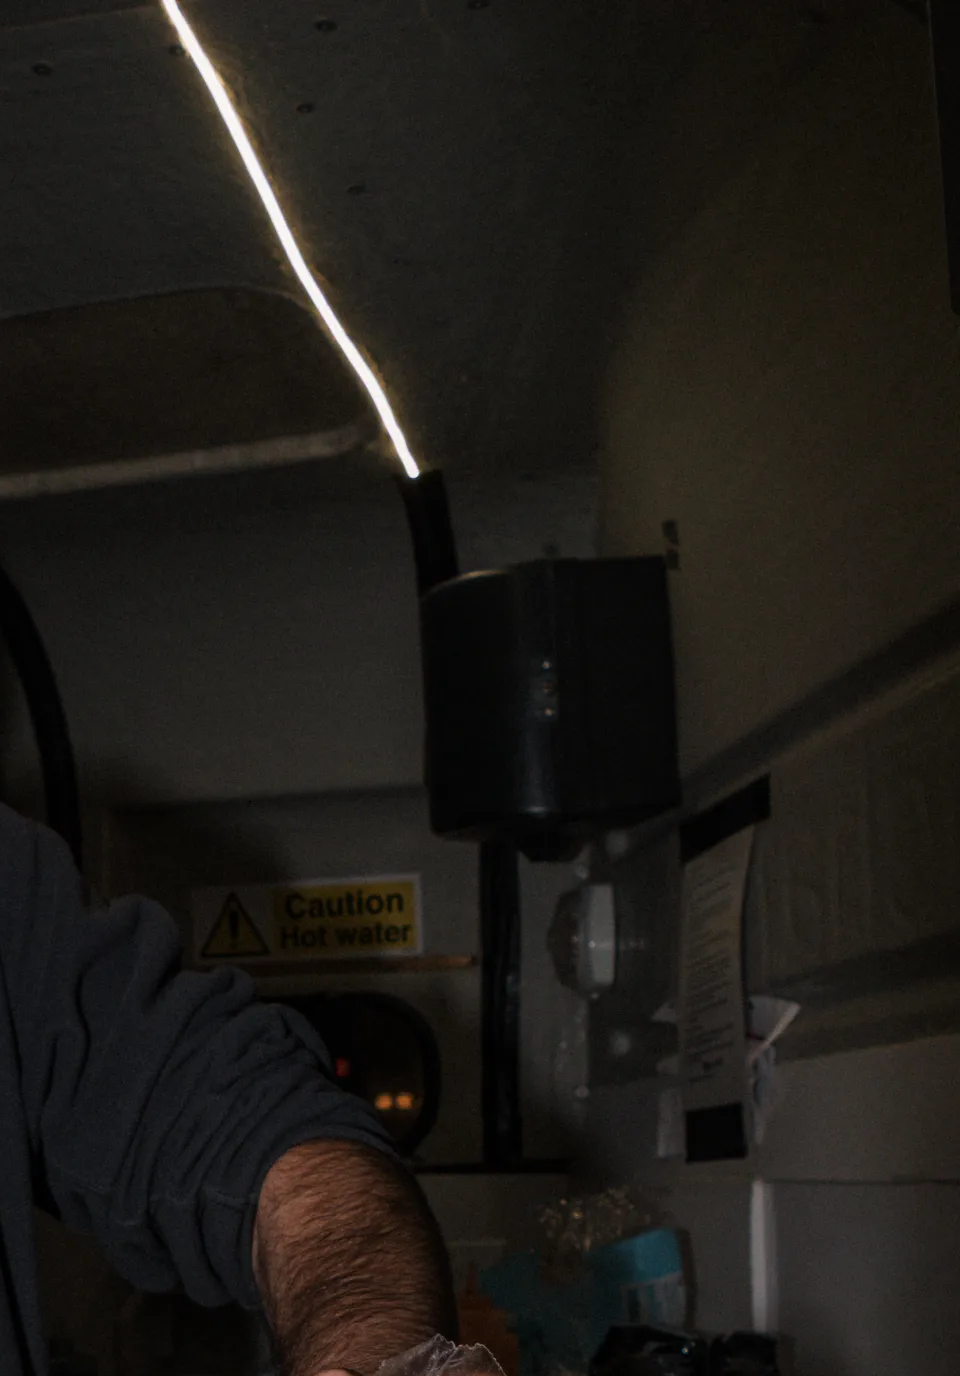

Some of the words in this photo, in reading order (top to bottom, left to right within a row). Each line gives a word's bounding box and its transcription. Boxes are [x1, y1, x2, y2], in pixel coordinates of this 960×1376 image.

[285, 889, 404, 919] Caution
[280, 925, 327, 949] Hot
[334, 921, 412, 946] water
